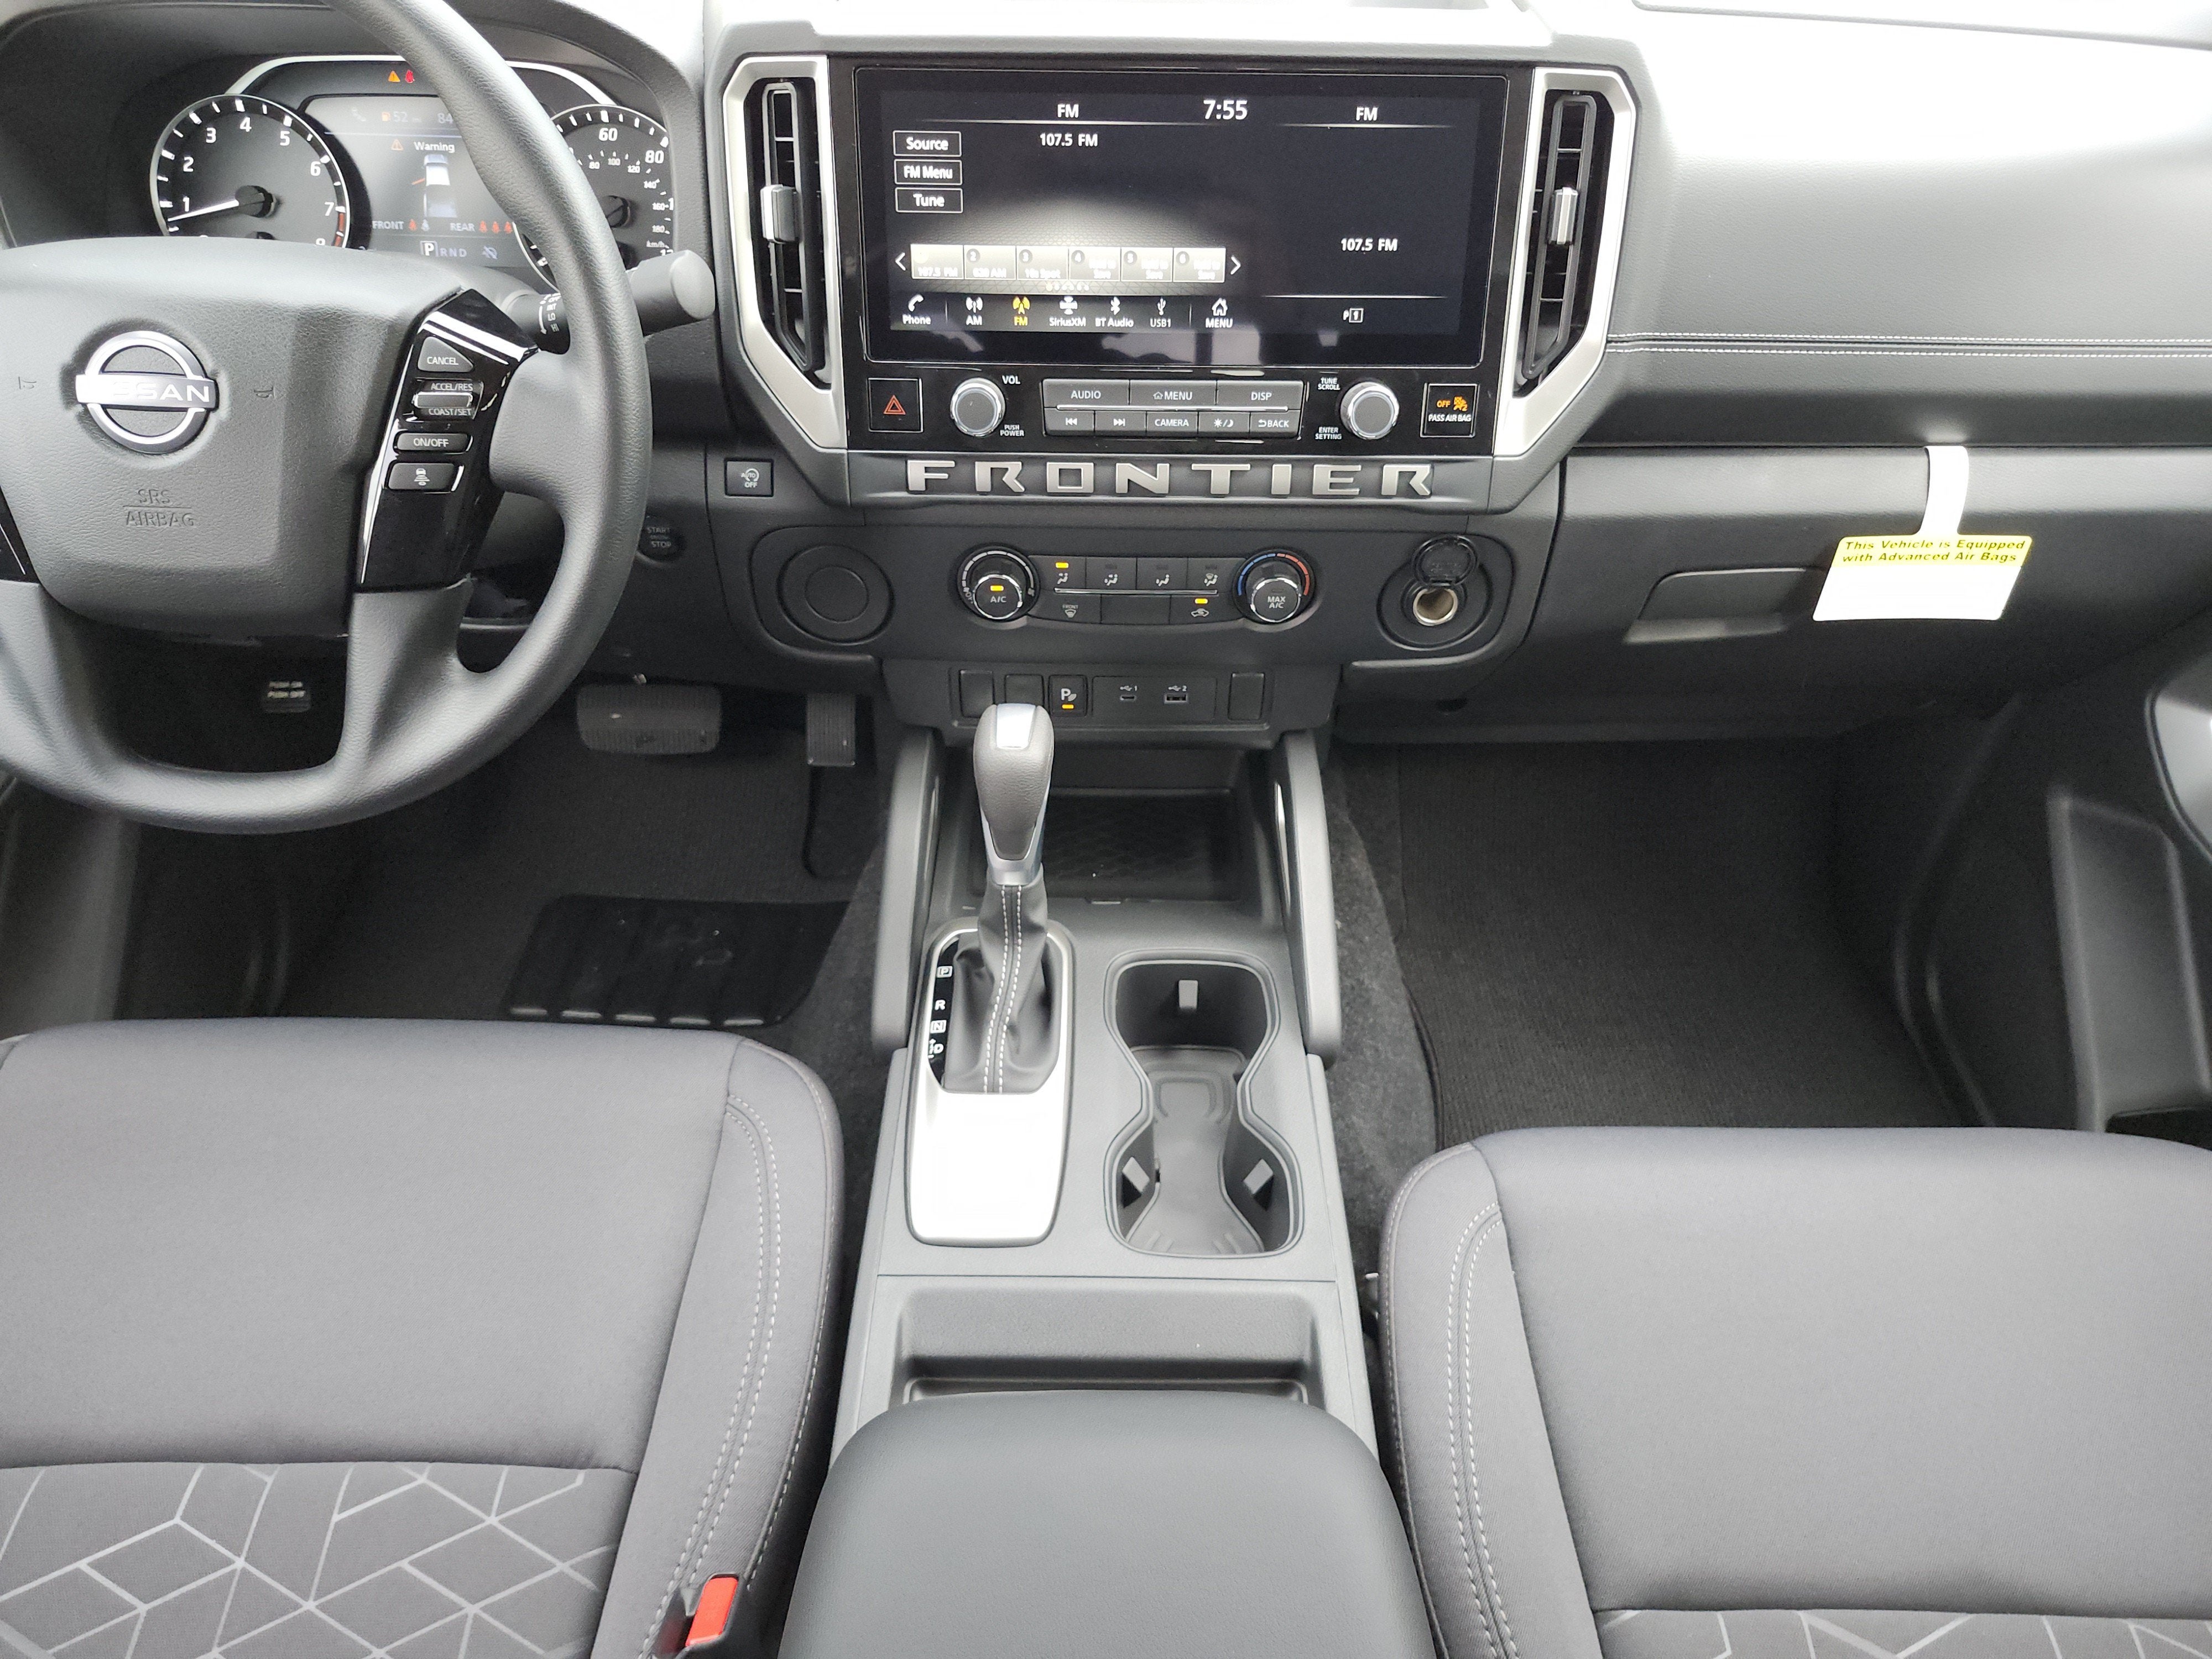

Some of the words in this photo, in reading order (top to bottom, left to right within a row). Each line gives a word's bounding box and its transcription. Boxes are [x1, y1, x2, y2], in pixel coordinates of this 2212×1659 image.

[1057, 103, 1079, 118] FM
[1203, 100, 1248, 119] 7:55
[1355, 106, 1378, 121] FM
[240, 117, 252, 132] 4
[206, 128, 216, 143] 3
[280, 131, 290, 146] 5
[599, 128, 618, 141] 60
[1040, 133, 1073, 147] 107.5
[1078, 133, 1098, 147] FM
[414, 142, 455, 153] Warning
[906, 137, 948, 151] Source
[645, 150, 664, 164] 80
[183, 157, 194, 172] 2
[311, 161, 321, 176] 6
[904, 165, 921, 179] FM
[922, 165, 953, 179] Menu
[183, 196, 190, 212] 1
[913, 194, 945, 207] Tune
[325, 202, 335, 216] 7
[372, 221, 404, 230] FRONT
[450, 222, 476, 232] REAR
[424, 242, 435, 257] P
[1341, 237, 1373, 251] 107.5
[1378, 238, 1398, 252] FM
[970, 251, 977, 261] 2
[1022, 252, 1029, 262] 3
[902, 314, 931, 325] Phone
[966, 315, 983, 326] AM
[1014, 316, 1029, 326] FM
[1049, 317, 1087, 327] SiriusXM
[1095, 317, 1107, 327] BT
[1108, 317, 1135, 328] Audio
[1150, 318, 1172, 328] USB1
[1205, 317, 1234, 328] MENU
[427, 356, 459, 366] CANCEL
[1002, 375, 1021, 385] VOL
[430, 383, 473, 392] ACCEL/RES
[1071, 390, 1101, 400] AUDIO
[1164, 392, 1193, 401] MENU
[1251, 392, 1273, 401] DISP
[1436, 400, 1451, 408] OFF
[428, 408, 472, 416] COAST/SET
[1155, 419, 1189, 427] CAMERA
[1428, 414, 1445, 422] PASS
[1445, 414, 1457, 422] AIR
[1458, 414, 1472, 422] BAG
[1267, 420, 1290, 428] BACK
[414, 438, 449, 447] ON/OFF
[906, 460, 1432, 496] FRONTIER
[138, 489, 170, 504] SRS
[126, 512, 195, 526] AIRBAG
[1845, 541, 1874, 550] This
[1881, 540, 1933, 549] Vehicle
[1939, 540, 1950, 549] is
[1957, 539, 2026, 551] Equipped
[1843, 553, 1873, 562] with
[1879, 552, 1950, 561] Advanced
[1955, 552, 1976, 561] Air
[1981, 552, 2017, 564] Bags
[1061, 688, 1071, 701] P
[935, 999, 946, 1010] R
[933, 1043, 944, 1053] D
